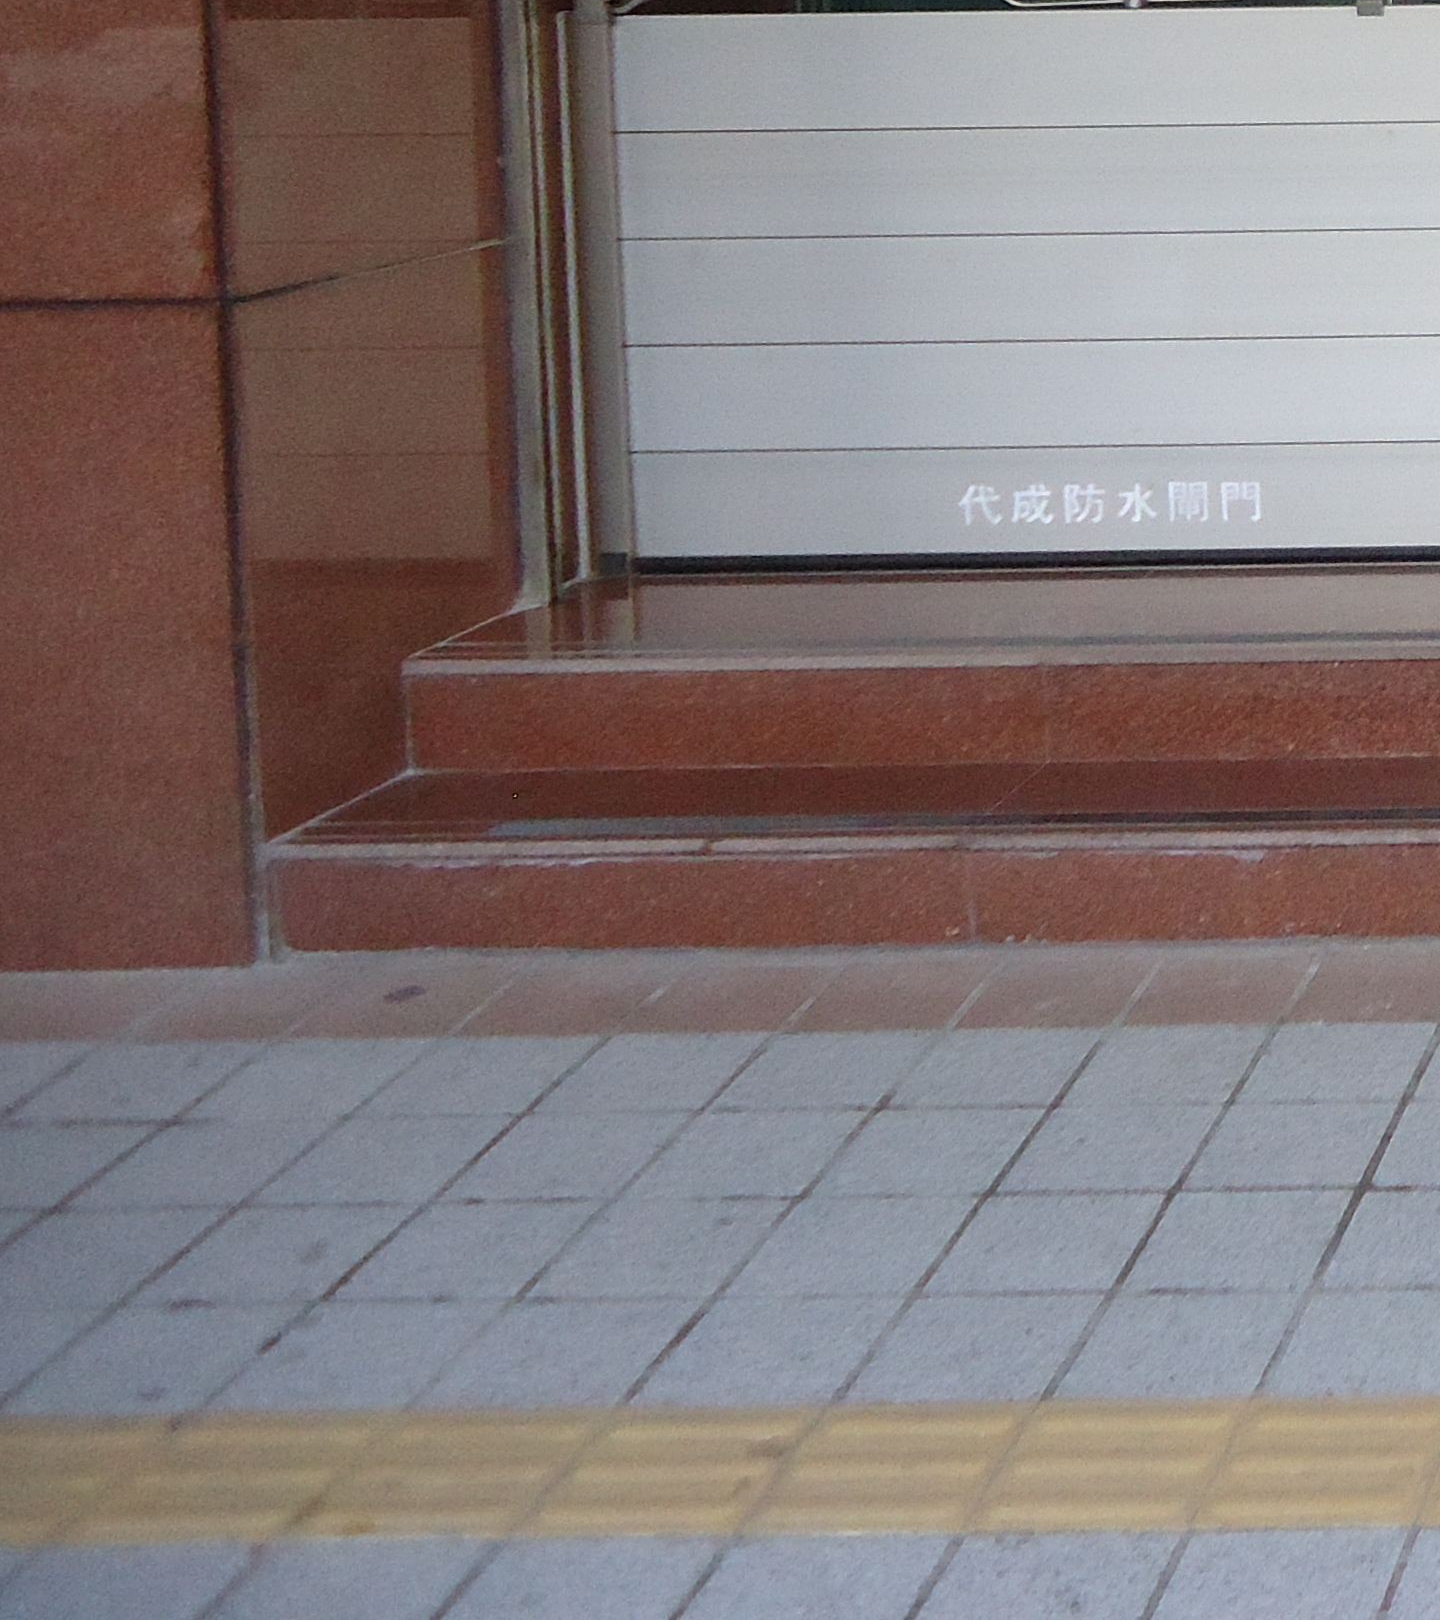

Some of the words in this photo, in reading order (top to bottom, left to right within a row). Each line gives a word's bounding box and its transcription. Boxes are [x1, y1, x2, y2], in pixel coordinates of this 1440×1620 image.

[957, 481, 1263, 527] 代成防水閘門
